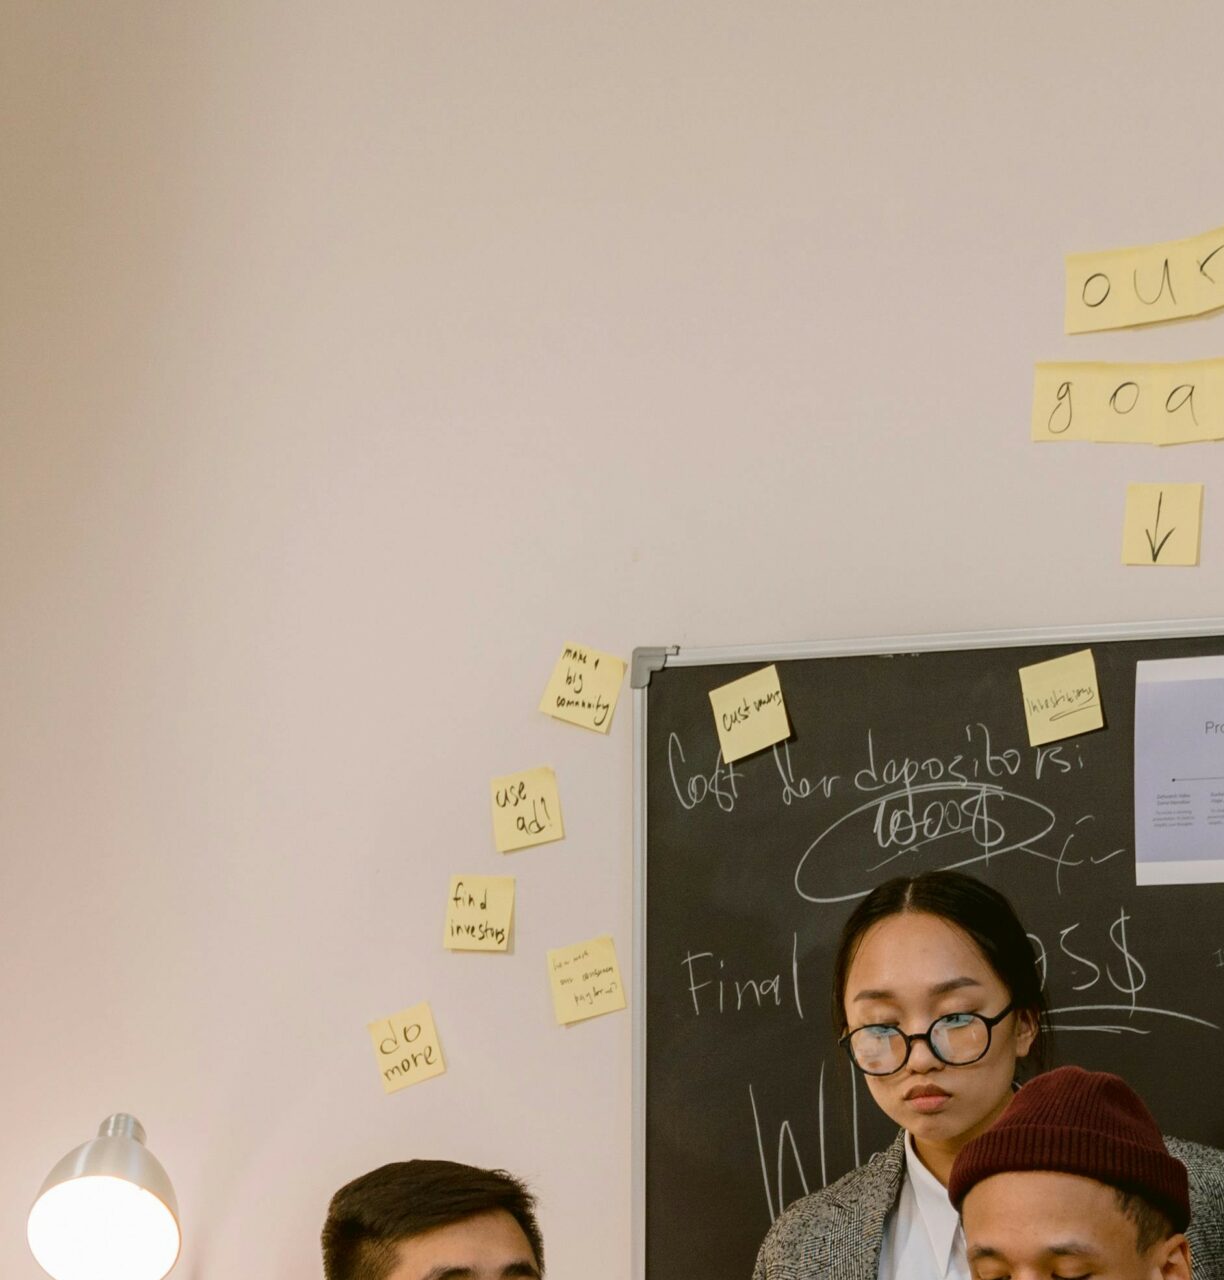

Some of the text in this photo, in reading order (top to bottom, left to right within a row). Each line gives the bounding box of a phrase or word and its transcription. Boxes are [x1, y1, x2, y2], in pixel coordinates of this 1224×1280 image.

[565, 666, 584, 694] big
[495, 780, 527, 808] use
[453, 881, 488, 911] find
[451, 919, 505, 945] investors
[681, 932, 803, 1020] Final
[379, 1018, 422, 1055] do
[383, 1044, 438, 1082] more
